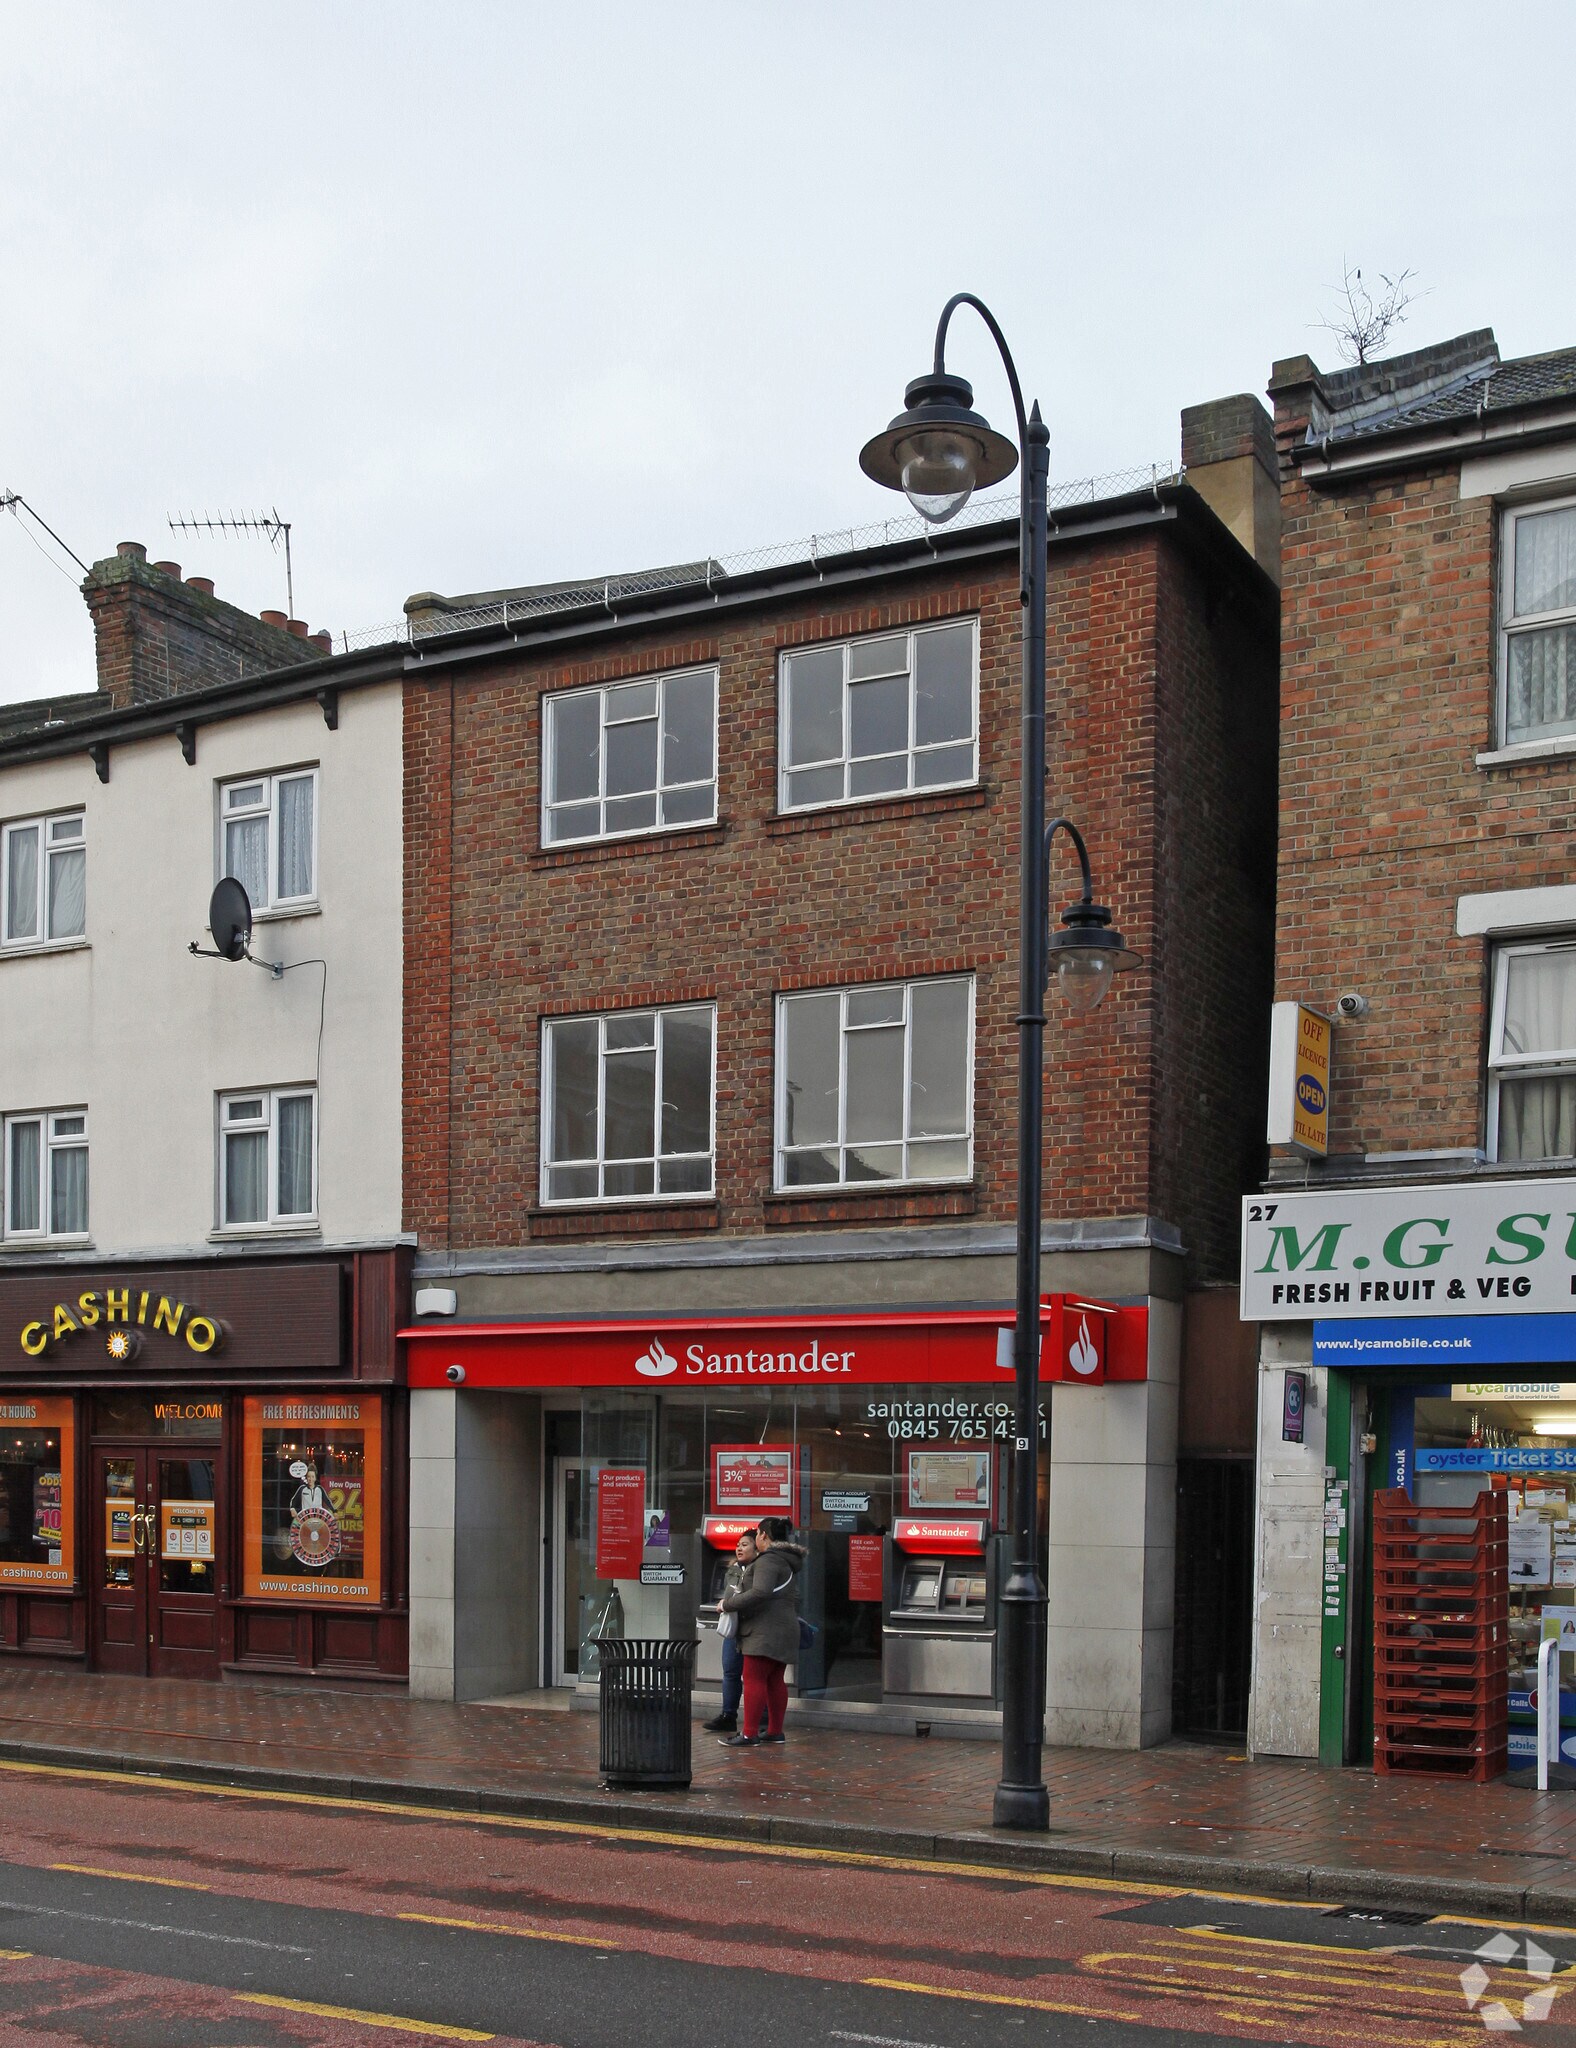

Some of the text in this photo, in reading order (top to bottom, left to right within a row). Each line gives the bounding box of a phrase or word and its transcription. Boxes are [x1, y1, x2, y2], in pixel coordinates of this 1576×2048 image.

[1303, 1018, 1323, 1042] OFF
[1298, 1044, 1326, 1069] LICENCE
[1300, 1082, 1324, 1108] OPEN
[1307, 1126, 1325, 1144] LATE
[1249, 1205, 1278, 1222] 27
[1254, 1212, 1576, 1273] M.G S
[1272, 1276, 1532, 1304] FRESH FRUIT & VEG
[20, 1287, 217, 1356] CASHINO
[1316, 1337, 1472, 1351] www.lycamobile.co.uk
[686, 1340, 856, 1374] Santander
[10, 1406, 36, 1419] HOURS
[263, 1405, 360, 1420] FREE REFRESHMENTS
[868, 1398, 1045, 1418] santander.co.k
[888, 1420, 1046, 1438] 0845 765 431
[1018, 1440, 1026, 1448] 9
[1428, 1452, 1484, 1468] oyster
[1490, 1451, 1550, 1467] Ticket
[724, 1470, 743, 1482] 3%
[1395, 1449, 1406, 1488] .co.uk
[345, 1481, 361, 1489] Open
[328, 1488, 363, 1519] 24
[339, 1520, 363, 1532] OURS
[922, 1527, 968, 1536] Santander
[260, 1581, 369, 1596] www.cashino.com
[1508, 1740, 1536, 1750] obile
